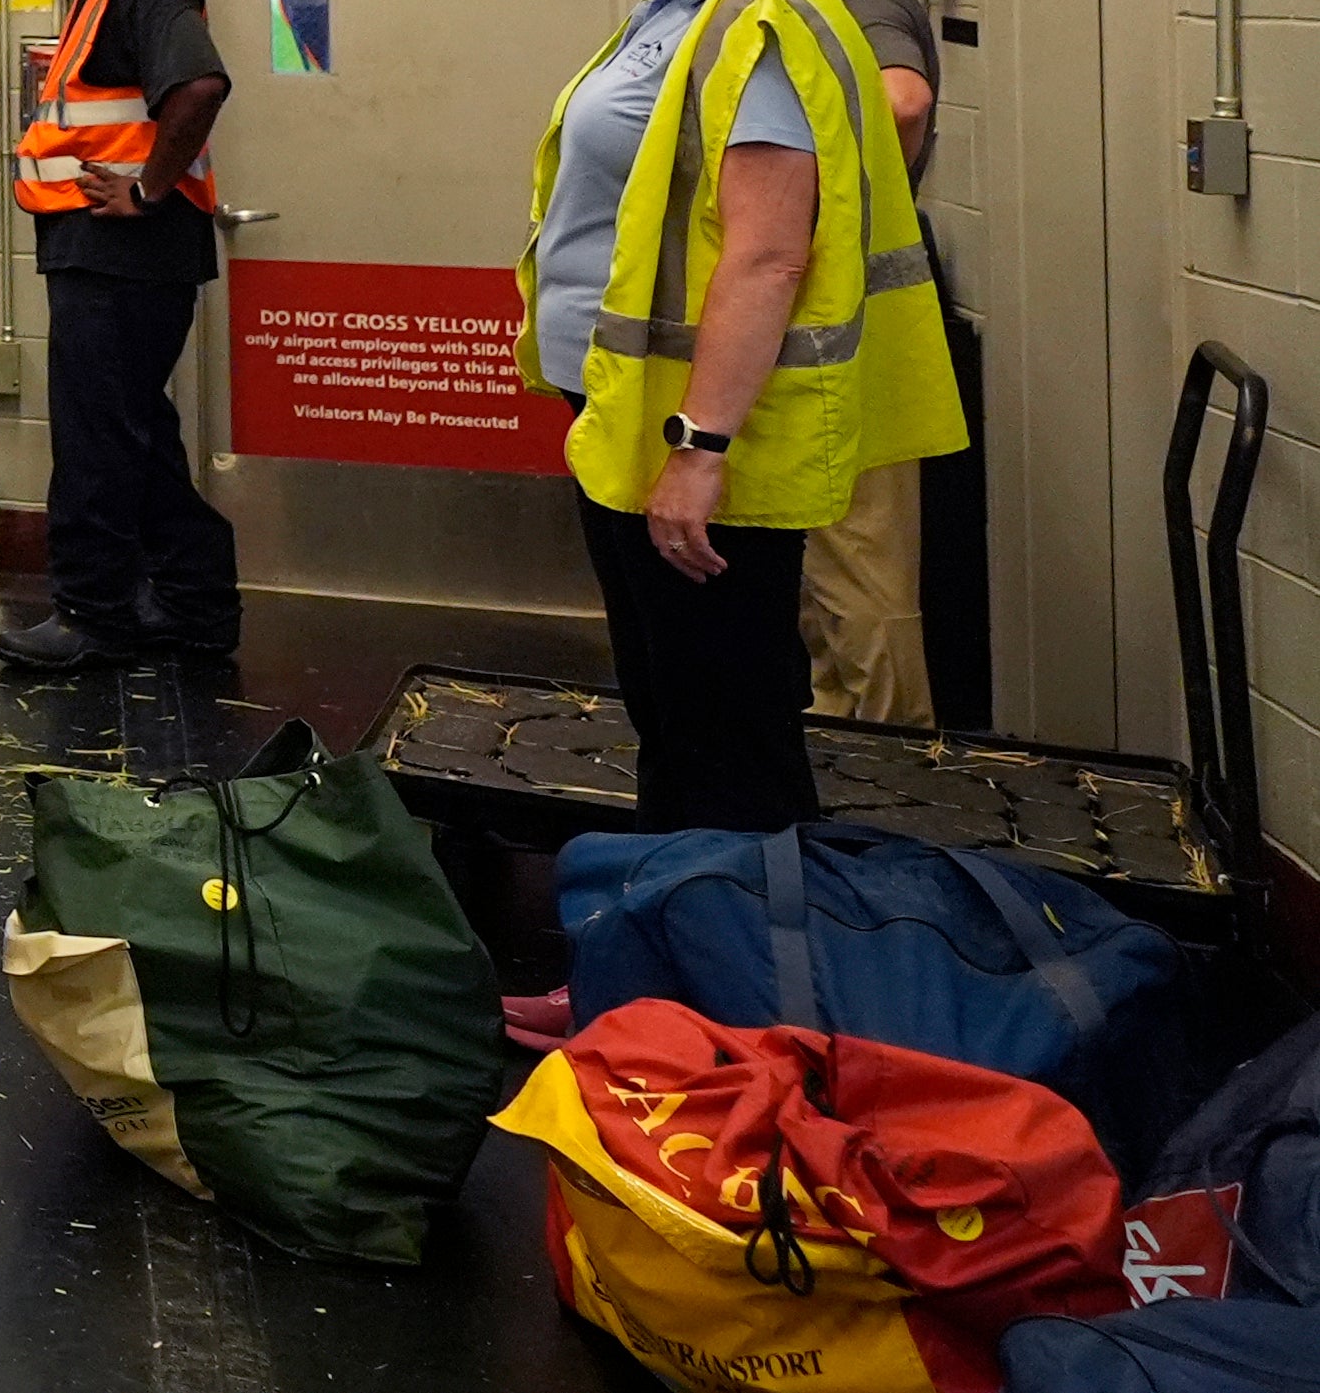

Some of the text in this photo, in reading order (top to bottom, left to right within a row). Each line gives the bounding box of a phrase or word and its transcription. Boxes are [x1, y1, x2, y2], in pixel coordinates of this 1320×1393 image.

[260, 309, 291, 326] DO
[295, 311, 338, 328] NOT
[343, 313, 408, 331] CROSS
[414, 315, 500, 336] YELLOW
[245, 334, 511, 357] only airport employees with SIDA
[276, 353, 306, 366] and
[309, 357, 357, 369] access
[361, 357, 438, 375] privileges
[442, 361, 460, 374] to
[464, 360, 494, 376] this
[293, 372, 517, 395] are allowed beyond this line
[294, 404, 519, 430] Violators May Be Prosecuted
[78, 1095, 143, 1116] sen
